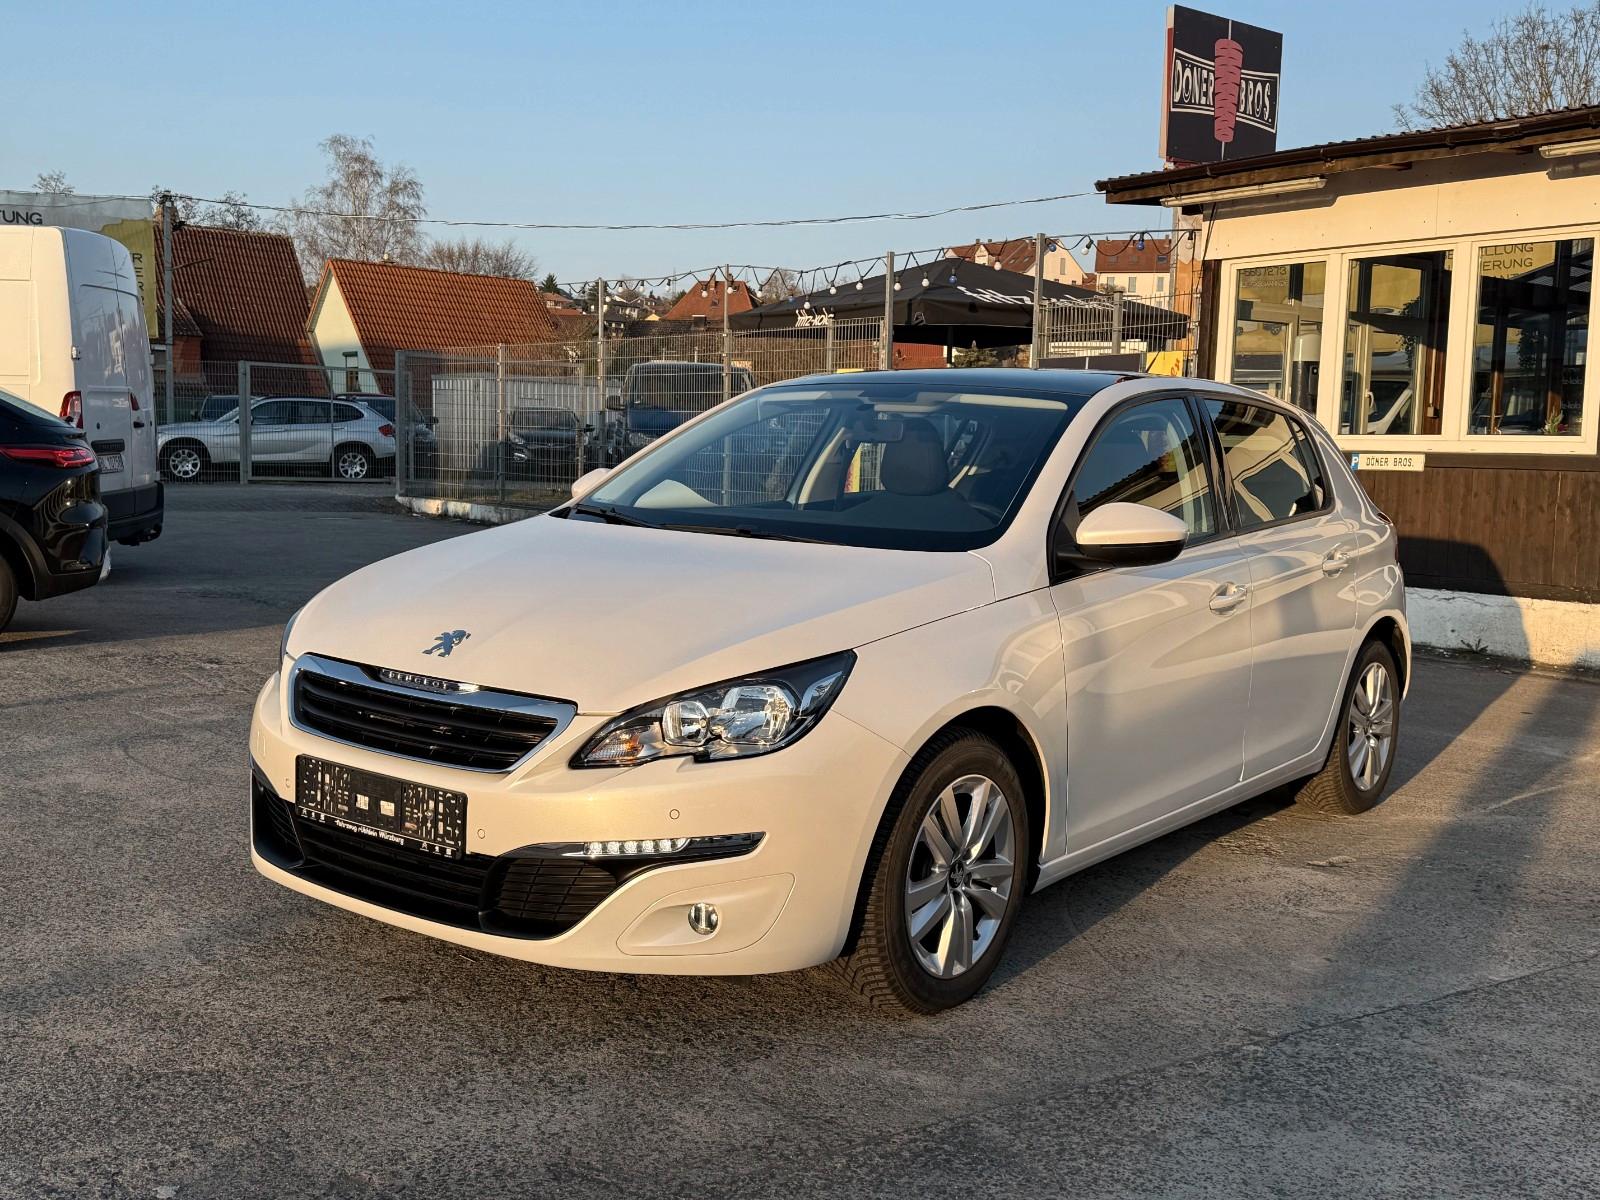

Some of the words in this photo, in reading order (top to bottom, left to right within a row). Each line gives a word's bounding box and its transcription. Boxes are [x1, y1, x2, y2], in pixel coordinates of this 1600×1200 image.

[1173, 59, 1214, 105] DÖNER
[1238, 80, 1272, 122] BROS.
[0, 209, 43, 225] UNG
[1366, 456, 1389, 467] DÖNER
[1393, 457, 1414, 468] BROS.
[381, 668, 448, 689] PEUGEOT
